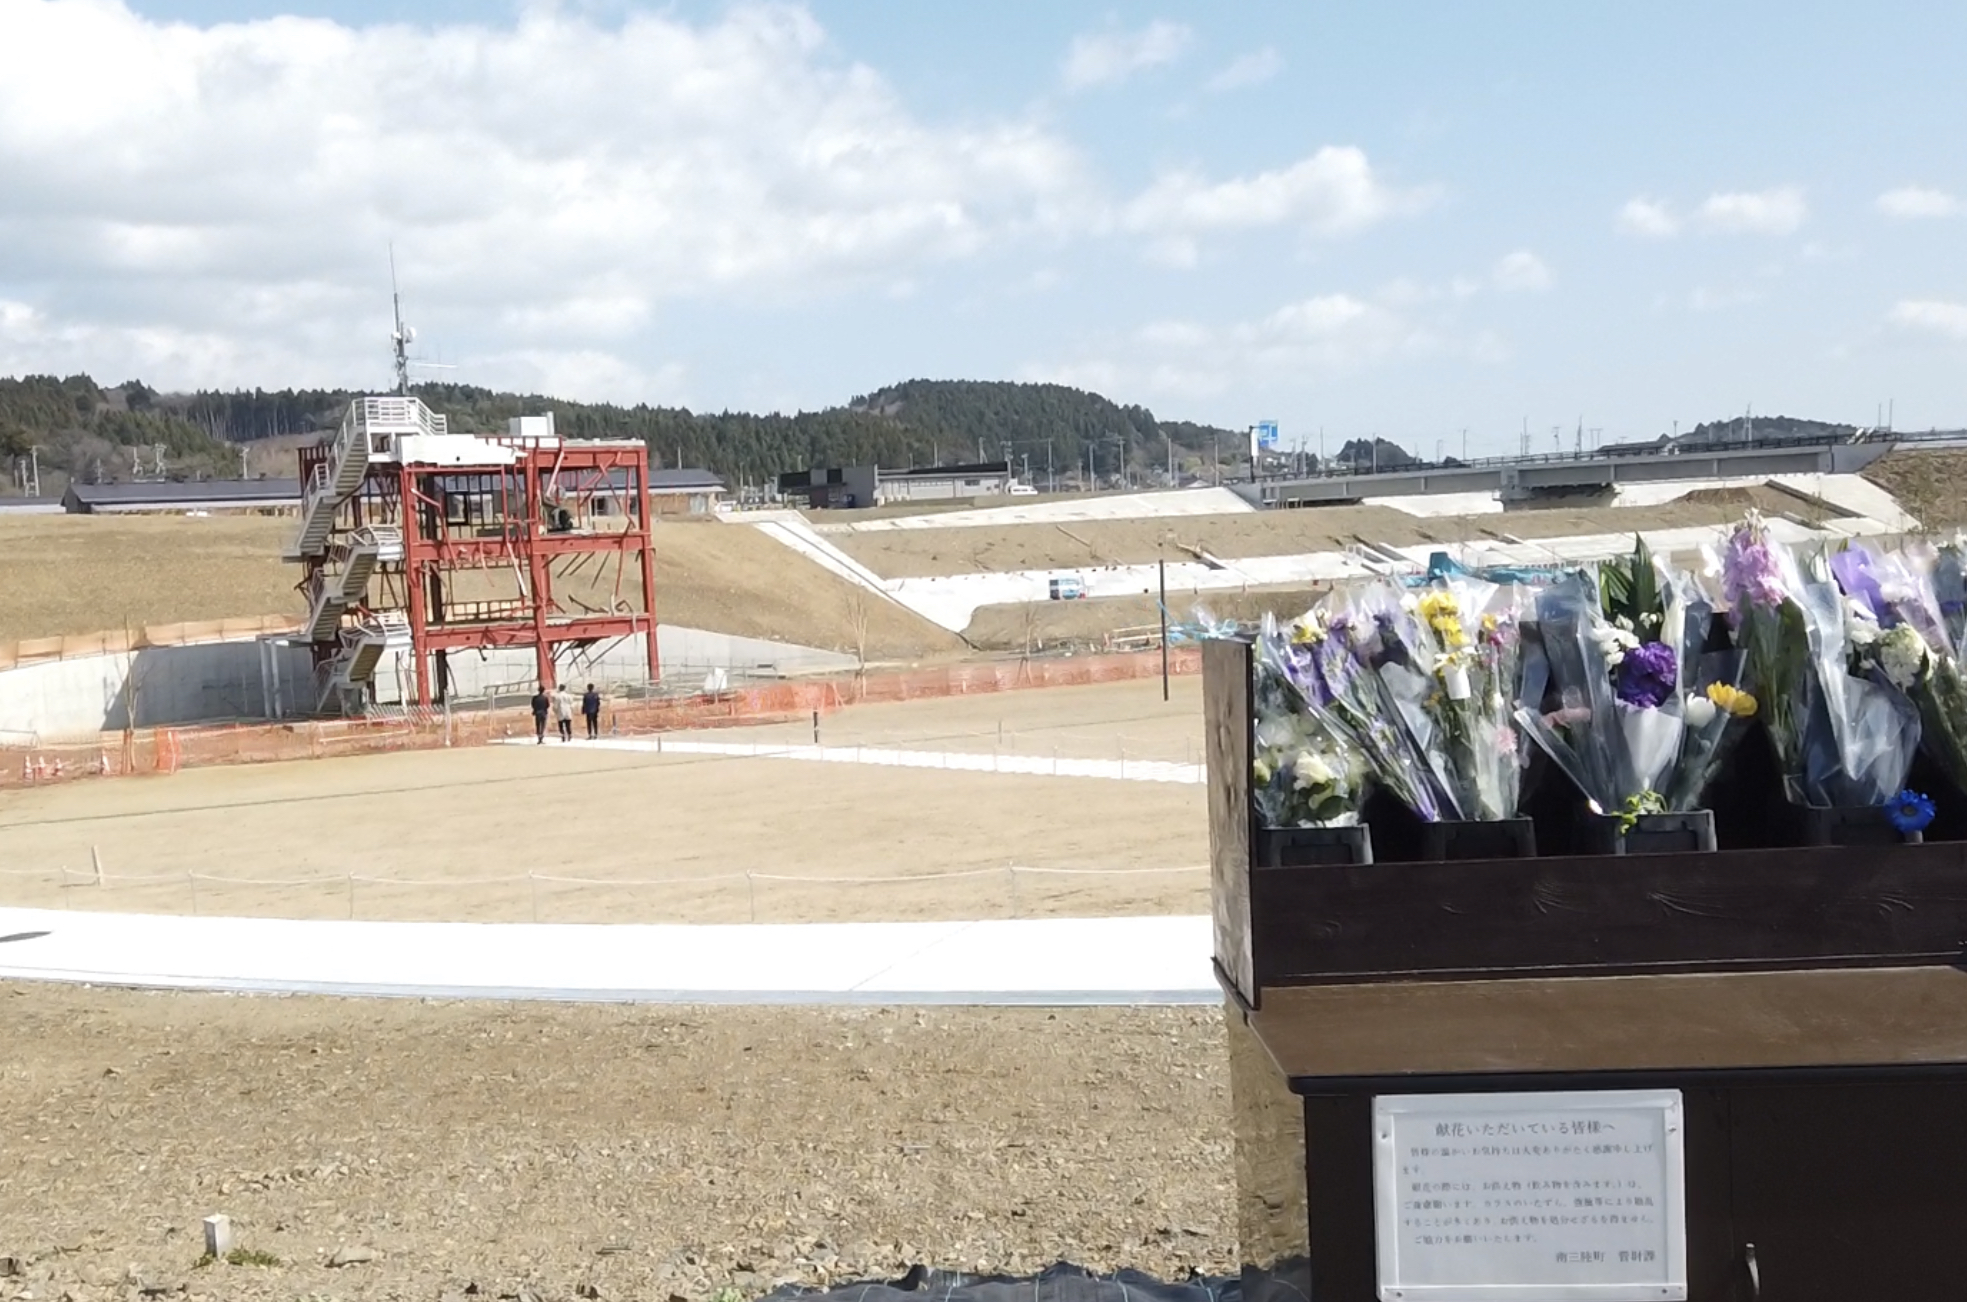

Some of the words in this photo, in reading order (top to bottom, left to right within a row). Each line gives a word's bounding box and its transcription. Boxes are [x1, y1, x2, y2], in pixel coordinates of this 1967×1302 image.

[1436, 1120, 1615, 1137] 献花いただいている皆様へ
[1556, 1250, 1606, 1263] 南三陸町
